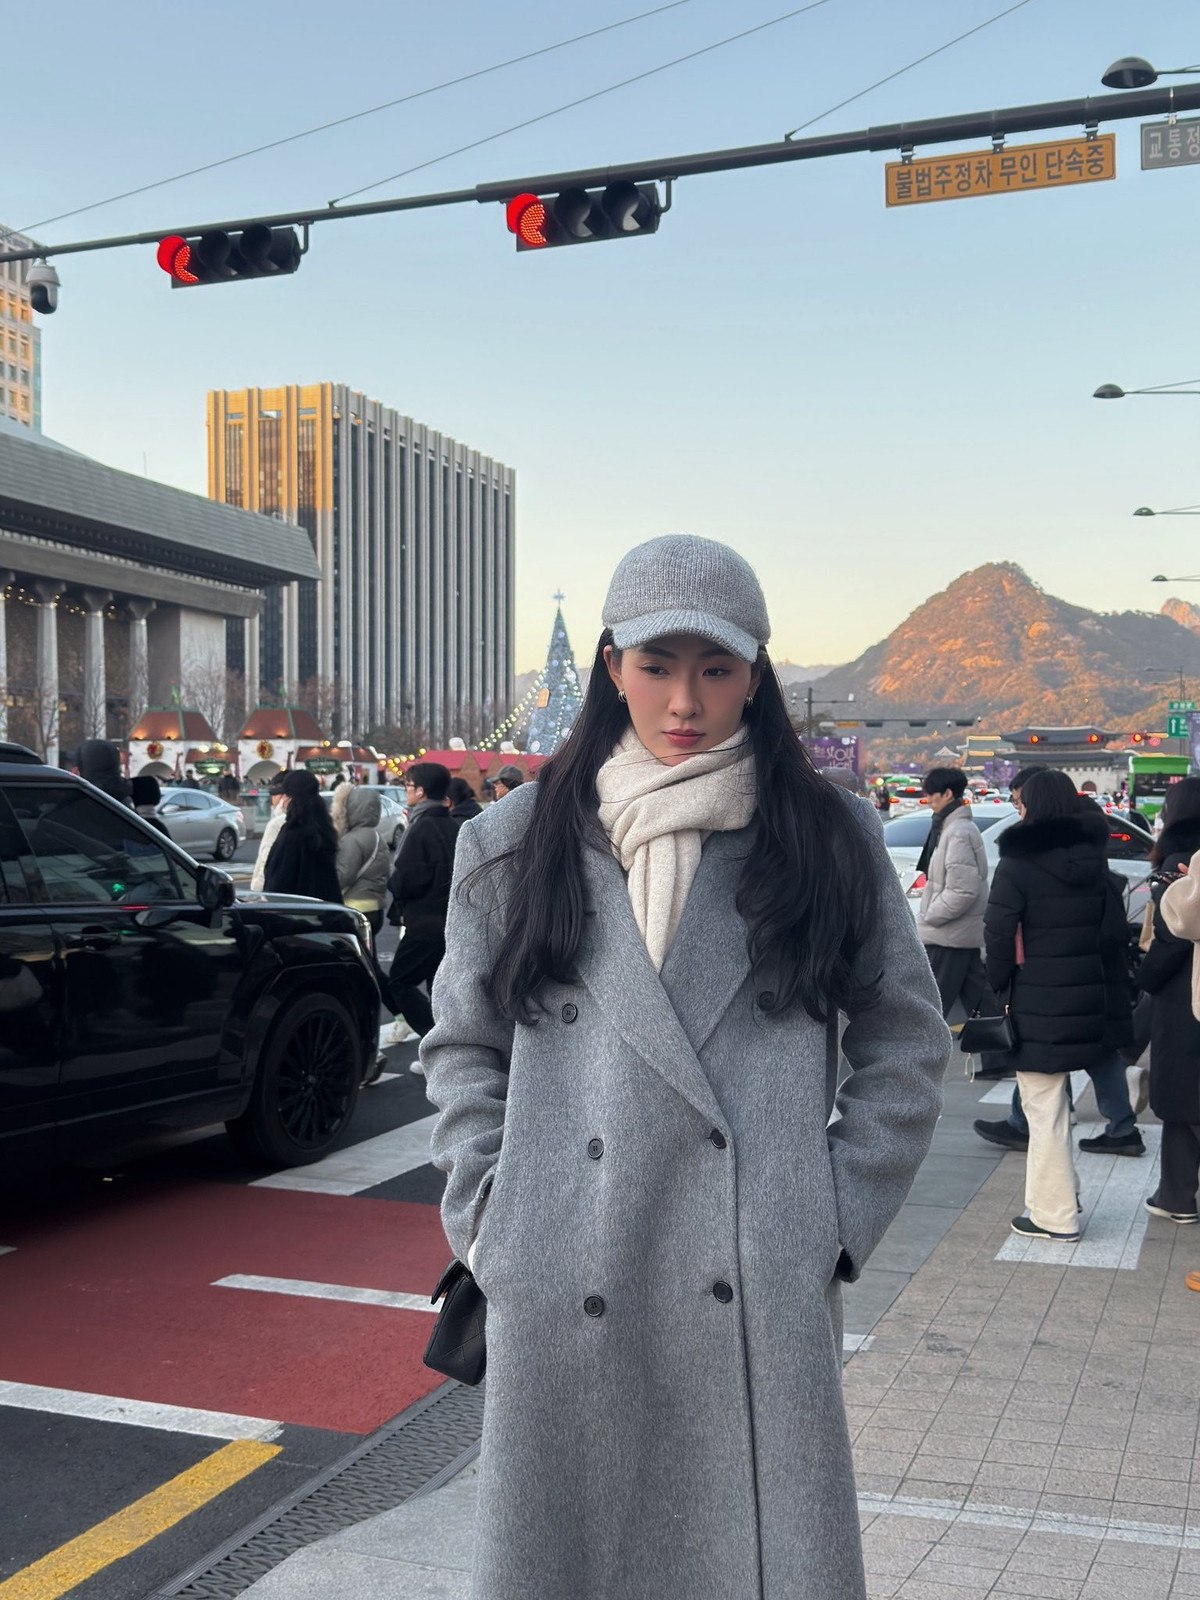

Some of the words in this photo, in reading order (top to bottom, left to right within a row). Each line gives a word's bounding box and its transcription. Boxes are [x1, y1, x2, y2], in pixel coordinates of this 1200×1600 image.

[895, 159, 992, 200] 불법주정차
[999, 153, 1037, 186] 무인
[1045, 145, 1105, 180] 단속중
